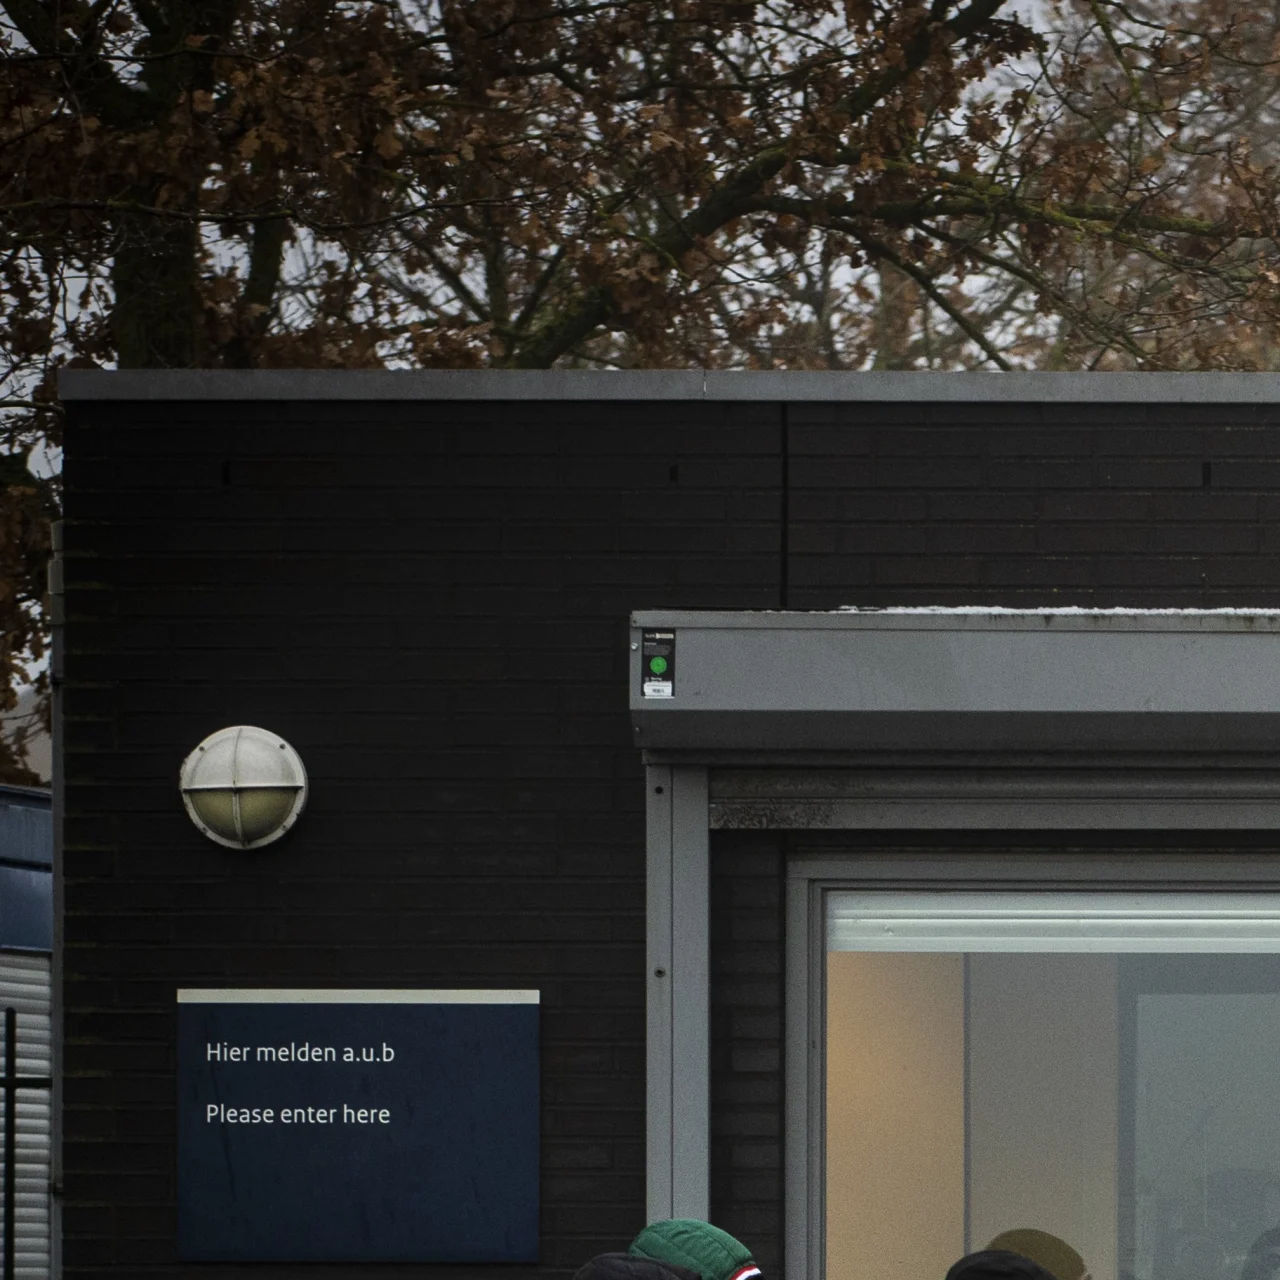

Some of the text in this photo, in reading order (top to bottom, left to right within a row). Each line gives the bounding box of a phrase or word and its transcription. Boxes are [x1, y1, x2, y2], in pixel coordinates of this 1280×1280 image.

[207, 1042, 395, 1062] Hier melden a.u.b
[207, 1103, 391, 1124] Please enter here
